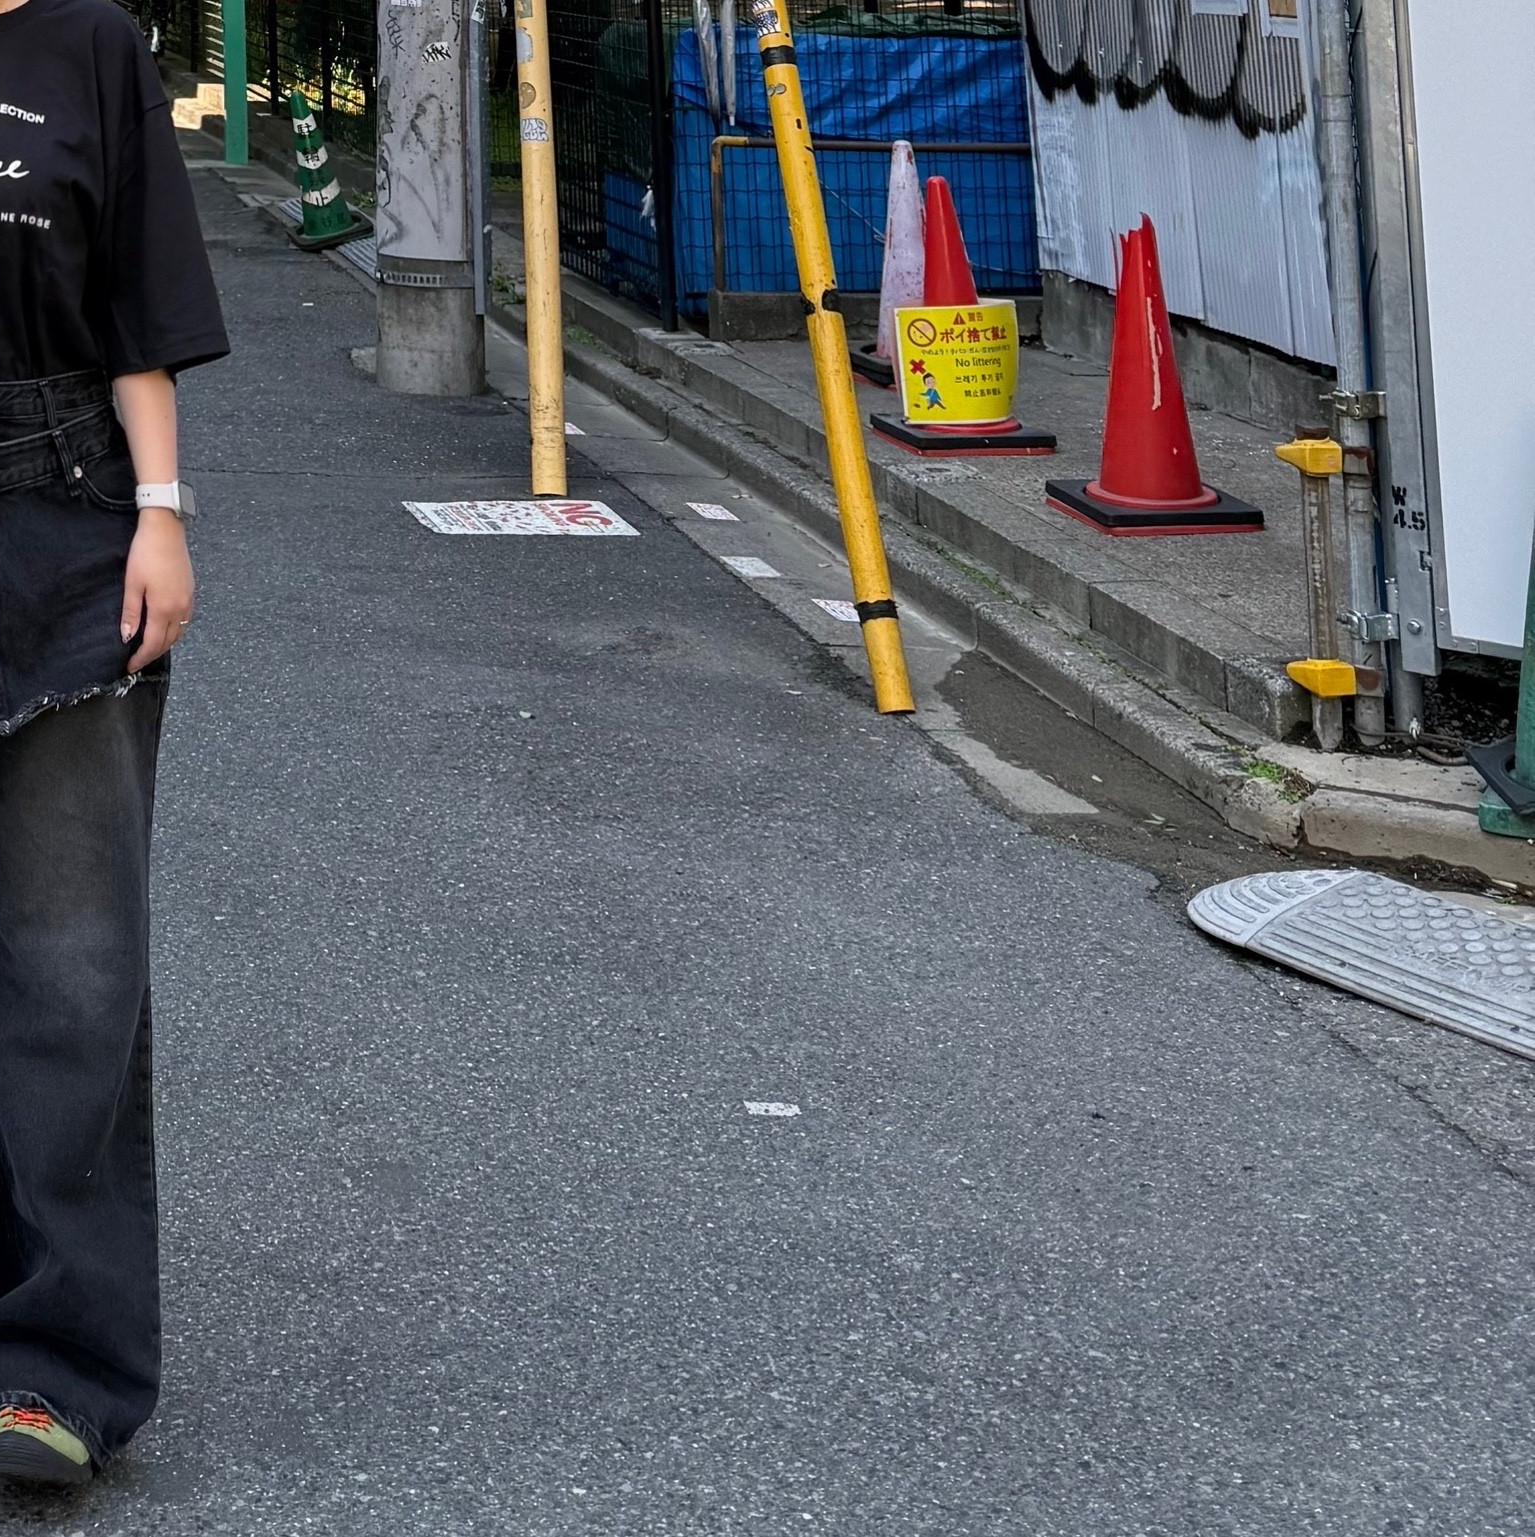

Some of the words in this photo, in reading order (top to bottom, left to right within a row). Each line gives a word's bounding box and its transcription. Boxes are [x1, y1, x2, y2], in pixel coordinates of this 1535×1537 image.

[20, 214, 51, 230] ROSE
[939, 325, 1008, 344] ポイ捨て禁止
[955, 358, 971, 368] No
[972, 357, 1002, 368] littering
[1393, 508, 1426, 531] 4.5
